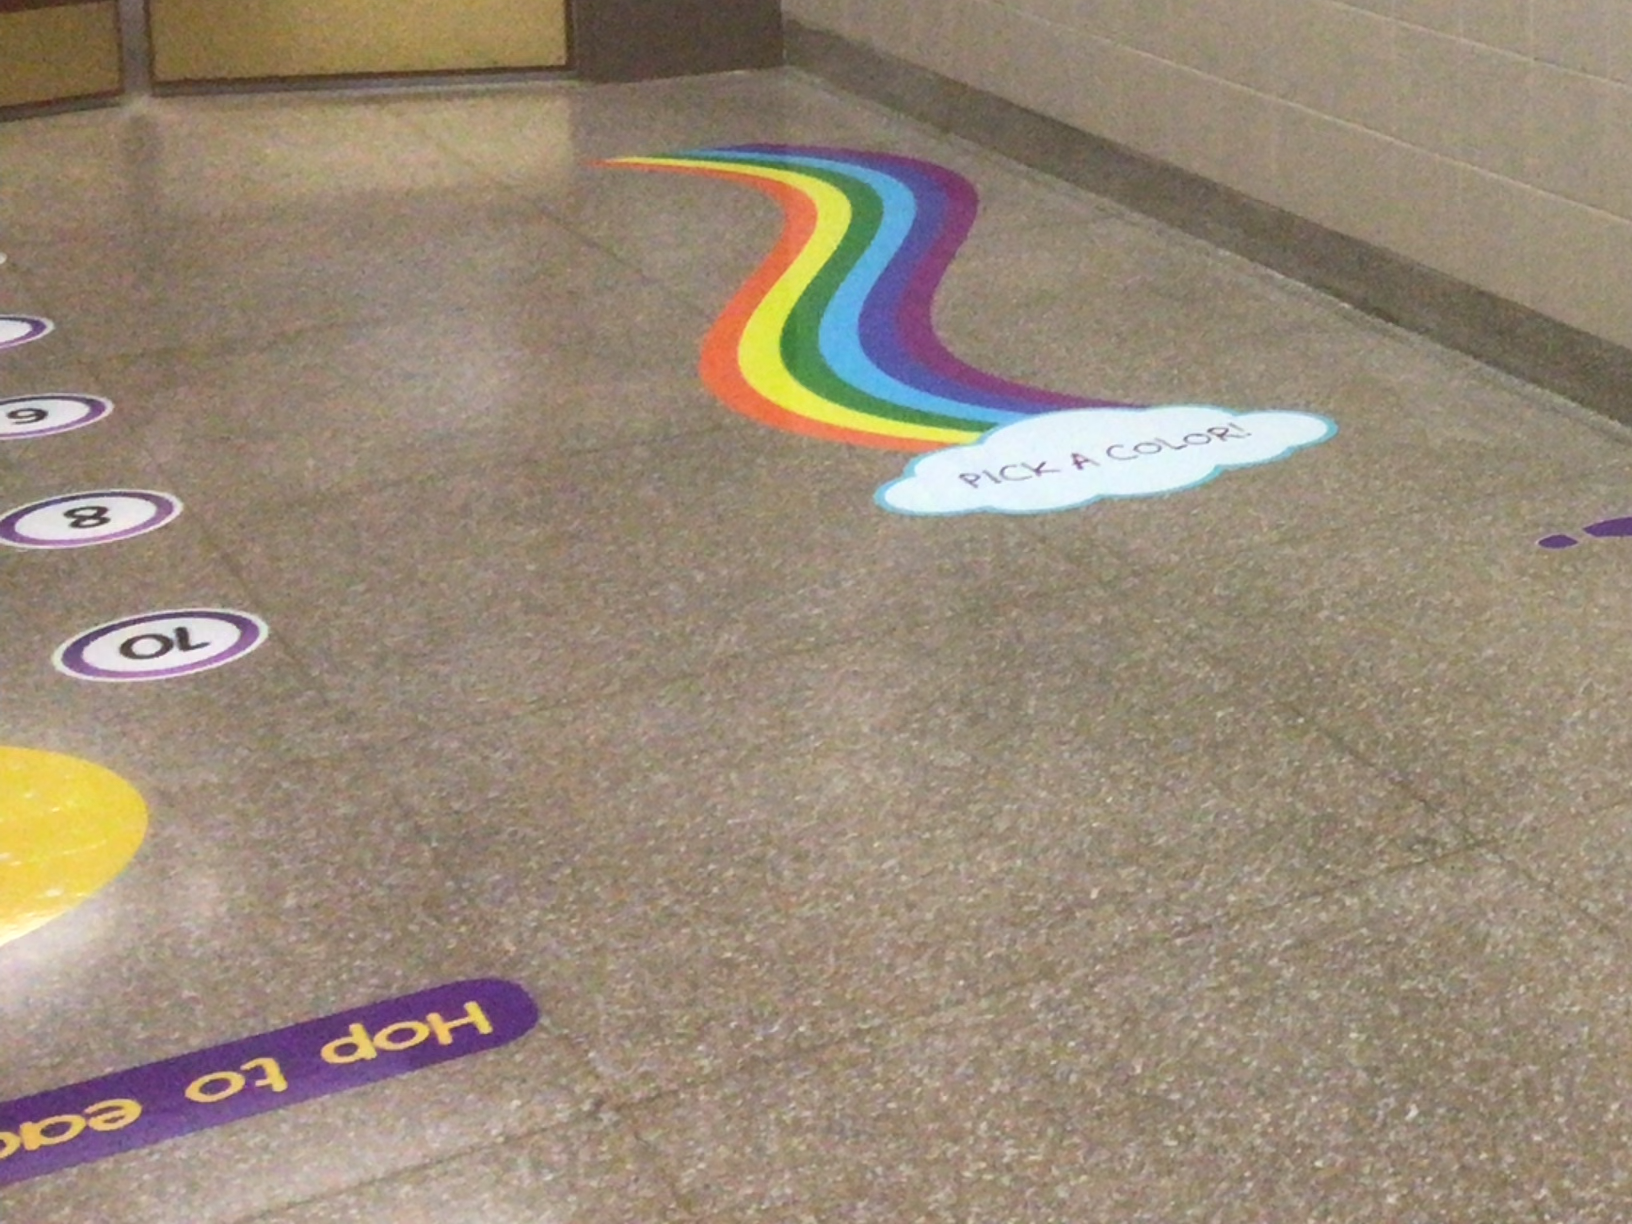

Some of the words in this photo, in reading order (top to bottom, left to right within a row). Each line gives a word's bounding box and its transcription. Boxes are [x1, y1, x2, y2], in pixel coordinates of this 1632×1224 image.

[958, 460, 1060, 489] PICK
[1071, 451, 1100, 471] A
[1105, 422, 1252, 462] COLOR!
[63, 506, 111, 529] 8
[119, 626, 211, 660] 10
[320, 1000, 494, 1065] Hop
[184, 1056, 288, 1104] to
